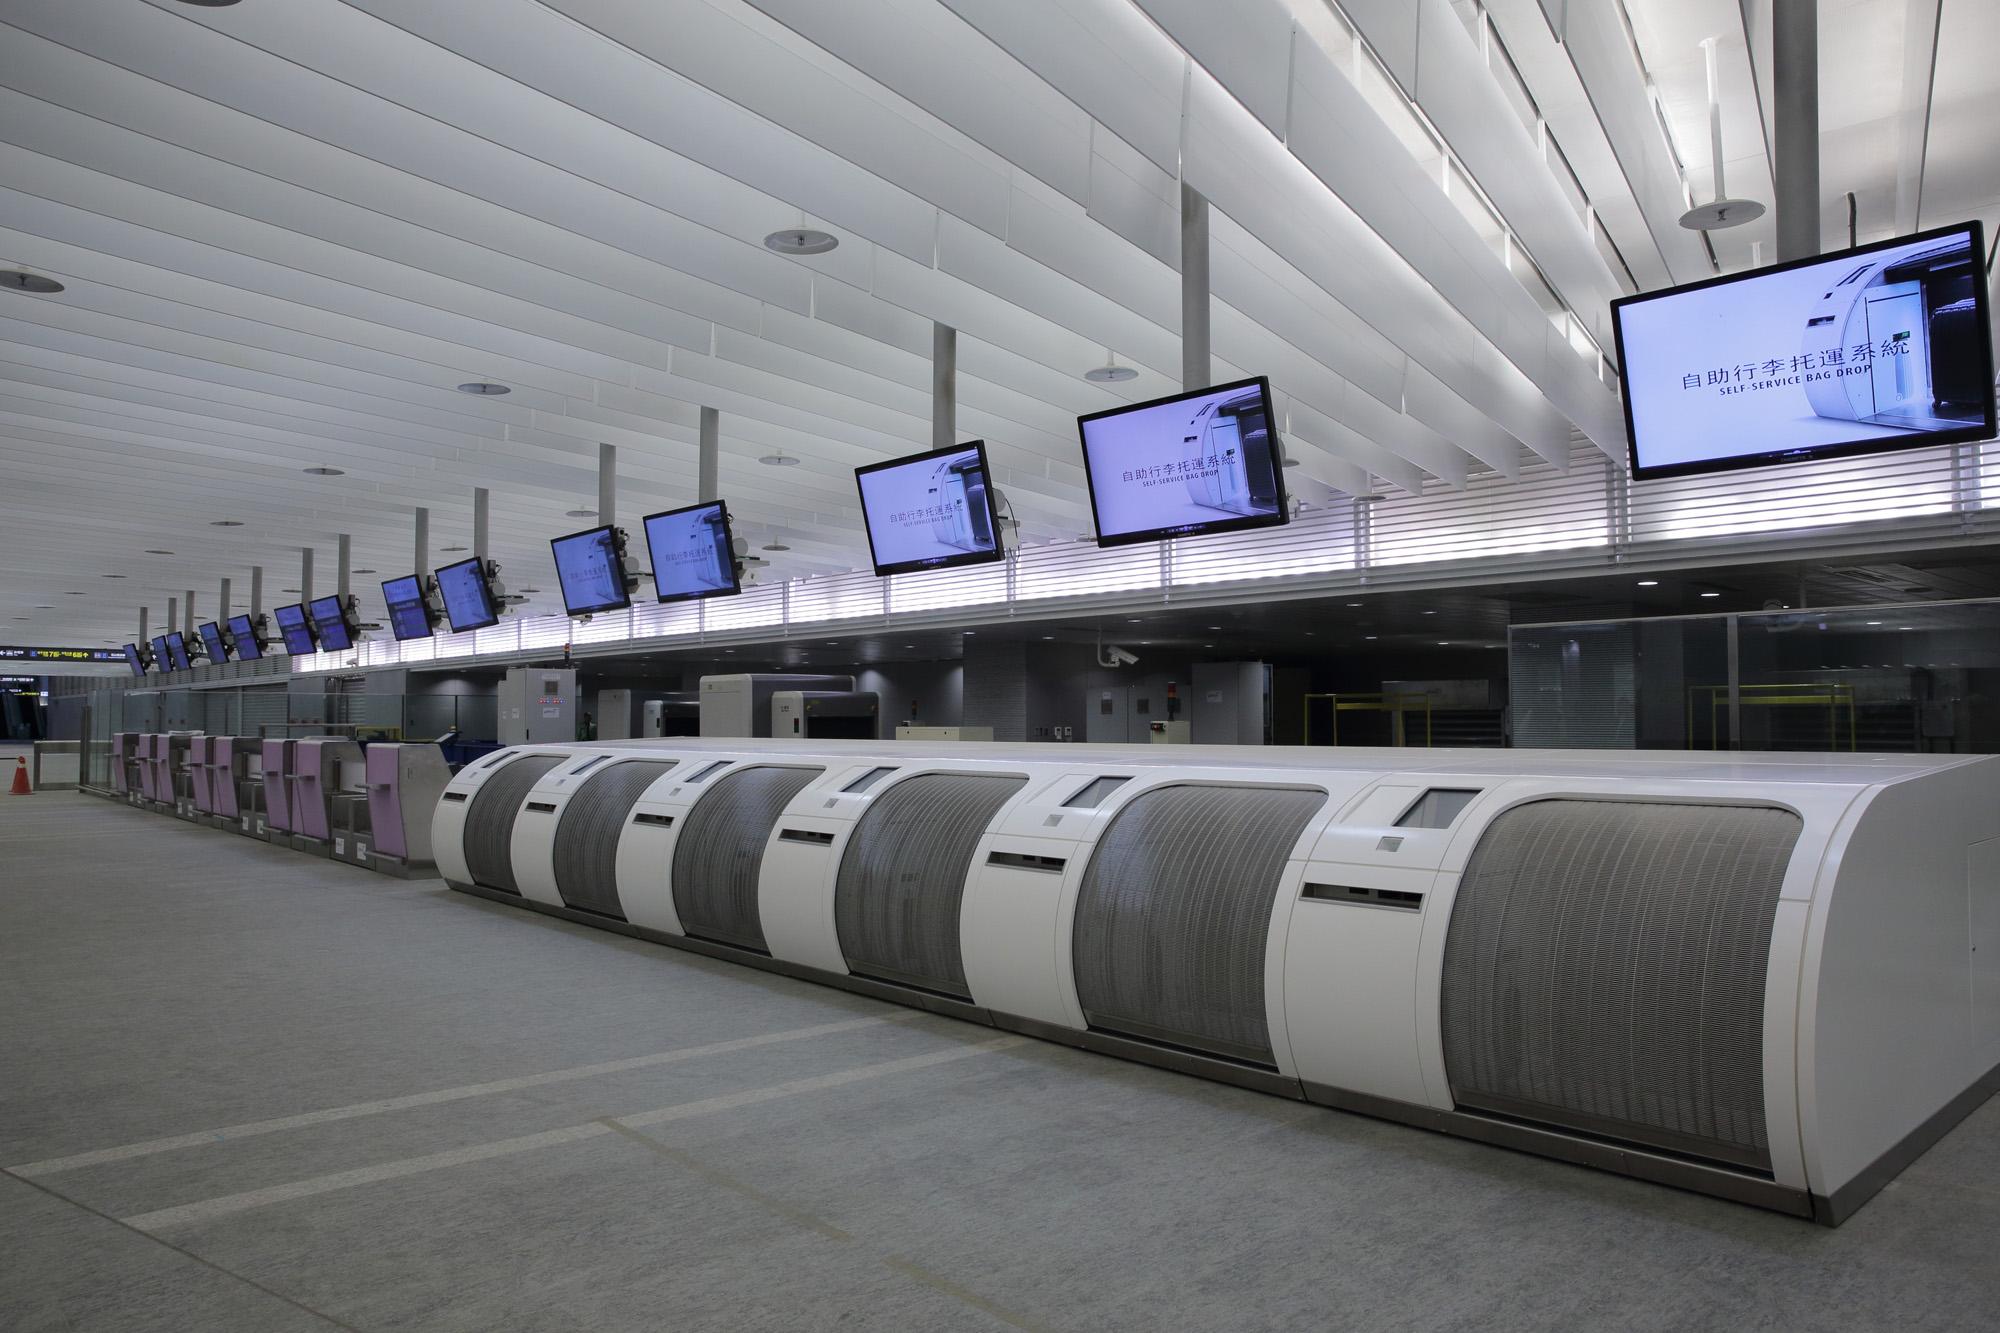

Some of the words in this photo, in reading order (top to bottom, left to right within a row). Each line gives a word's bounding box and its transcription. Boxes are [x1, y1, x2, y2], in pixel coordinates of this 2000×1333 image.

[1682, 339, 1910, 390] 自助行李托運系統
[1719, 375, 1801, 396] SELF-SERVICE
[1806, 370, 1831, 382] BAG
[1836, 364, 1872, 377] DROP
